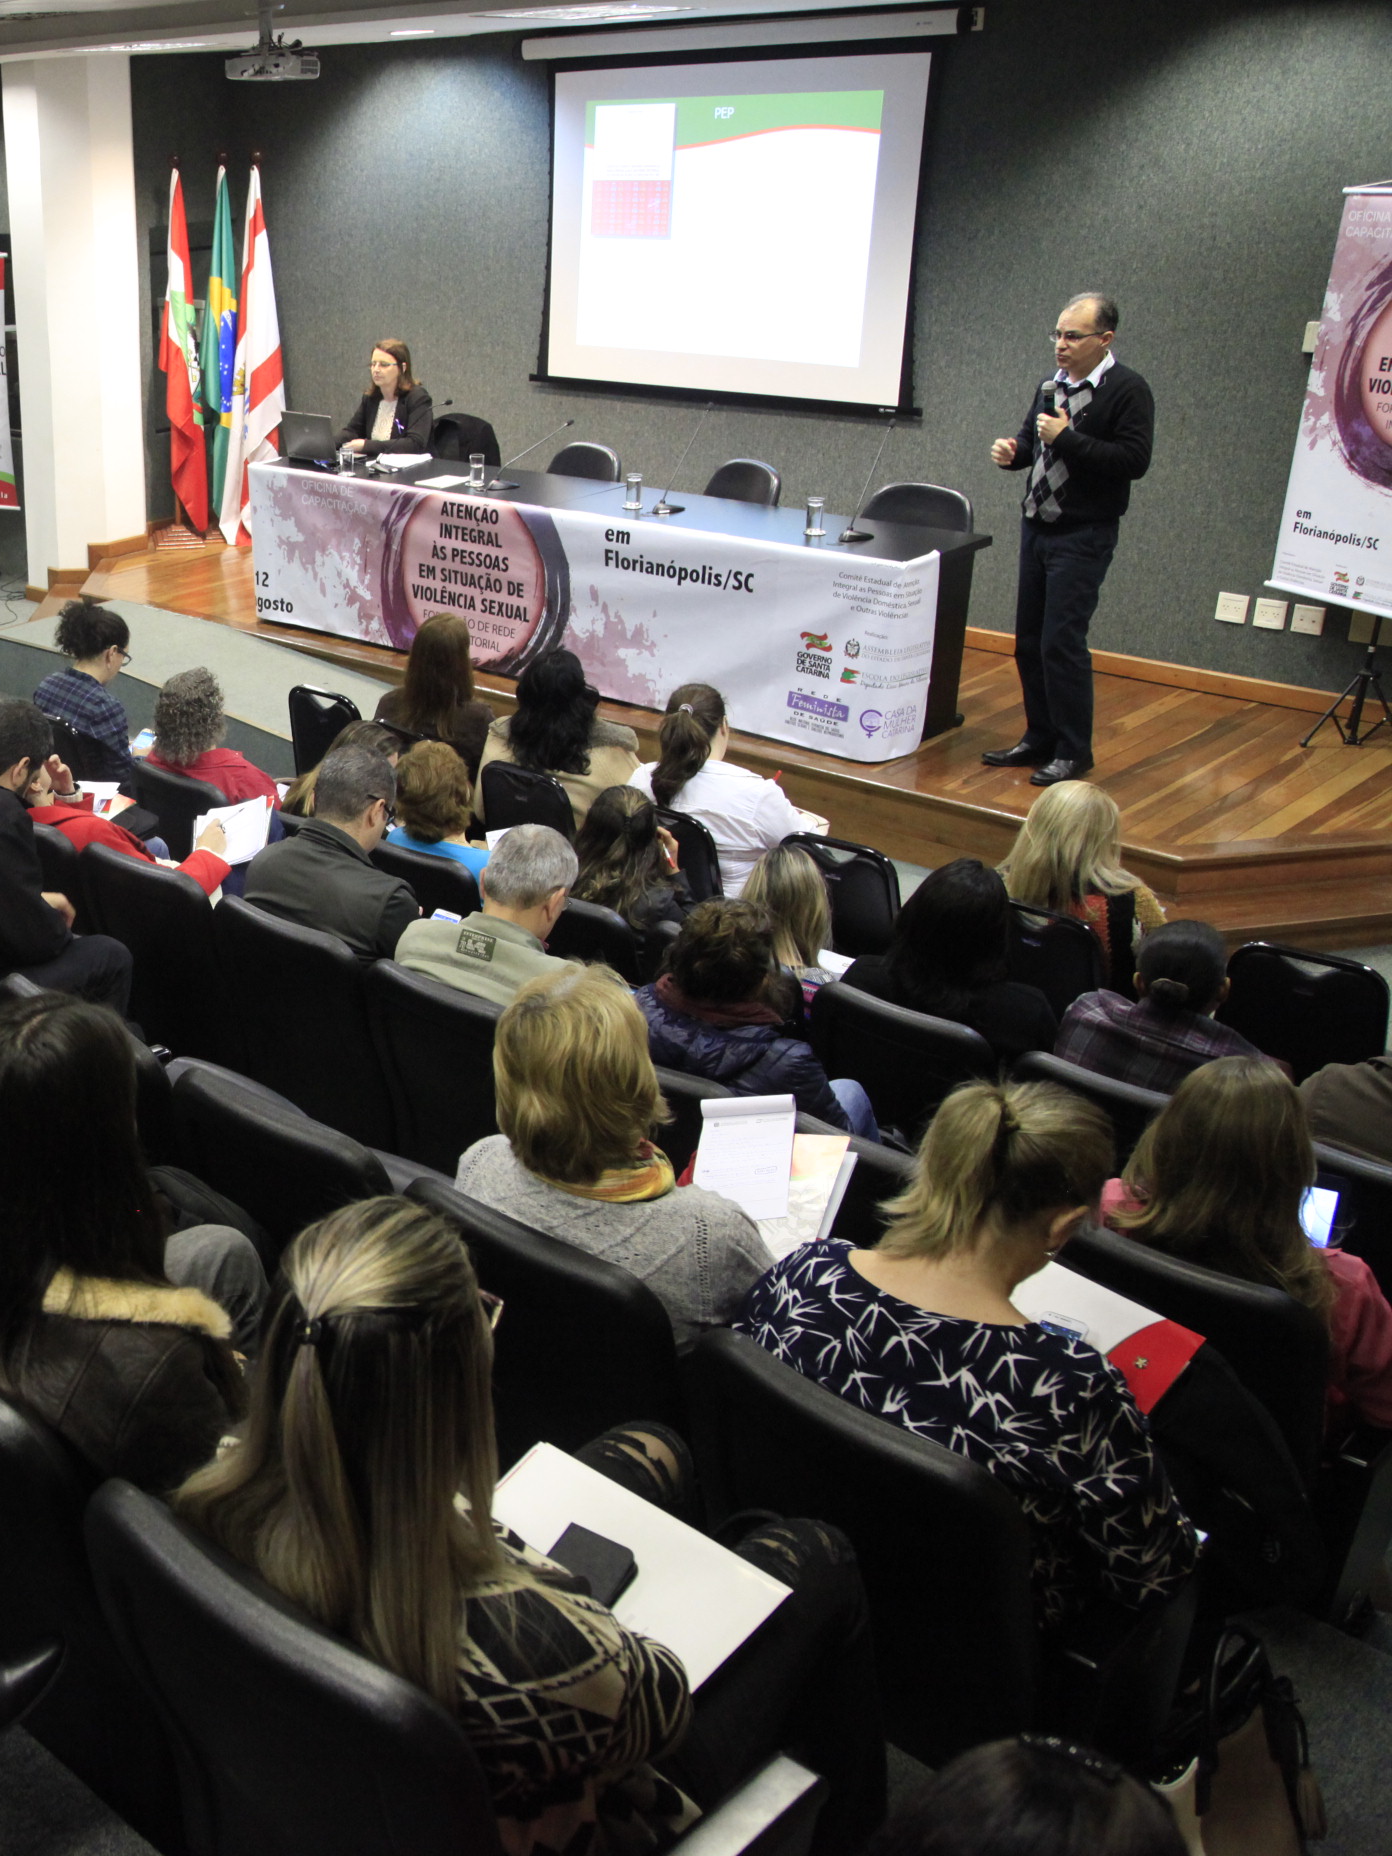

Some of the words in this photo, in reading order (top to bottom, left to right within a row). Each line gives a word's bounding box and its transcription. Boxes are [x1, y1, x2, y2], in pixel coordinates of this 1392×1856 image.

[714, 106, 735, 120] PEP
[1348, 210, 1392, 222] OFICINA
[1345, 226, 1392, 239] CAPACIT
[301, 480, 338, 495] OFICINA
[340, 486, 354, 498] DE
[301, 494, 367, 515] CAPACITAÇÃO
[441, 501, 499, 526] ATENÇÃO
[1296, 509, 1312, 519] em
[439, 523, 502, 548] INTEGRAL
[605, 528, 631, 545] em
[1293, 521, 1380, 550] Florianópolis/SC
[432, 541, 447, 560] ÀS
[451, 548, 509, 572] PESSOAS
[605, 549, 754, 593] Florianópolis/SC
[419, 563, 436, 580] EM
[440, 568, 502, 594] SITUAÇÃO
[507, 581, 524, 598] DE
[864, 576, 892, 587] Estadual
[893, 581, 902, 589] de
[833, 581, 858, 591] Integral
[868, 587, 892, 597] Pessoas
[256, 596, 293, 613] gosto
[412, 584, 476, 611] VIOLÊNCIA
[480, 598, 530, 623] SEXUAL
[843, 593, 872, 604] Violência
[856, 605, 877, 615] Outras
[477, 621, 490, 632] DE
[492, 624, 516, 639] REDE
[470, 636, 501, 652] TORIAL
[796, 658, 806, 667] DE
[808, 660, 831, 672] SANTA
[797, 651, 832, 665] GOVERNO
[796, 665, 830, 680] CATARINA
[797, 687, 841, 703] REDE
[791, 693, 845, 718] Feminista
[885, 707, 905, 721] CASA
[906, 705, 917, 716] DA
[808, 715, 839, 726] SAÚDE
[883, 714, 917, 730] MULHER
[881, 725, 916, 739] CATARINA
